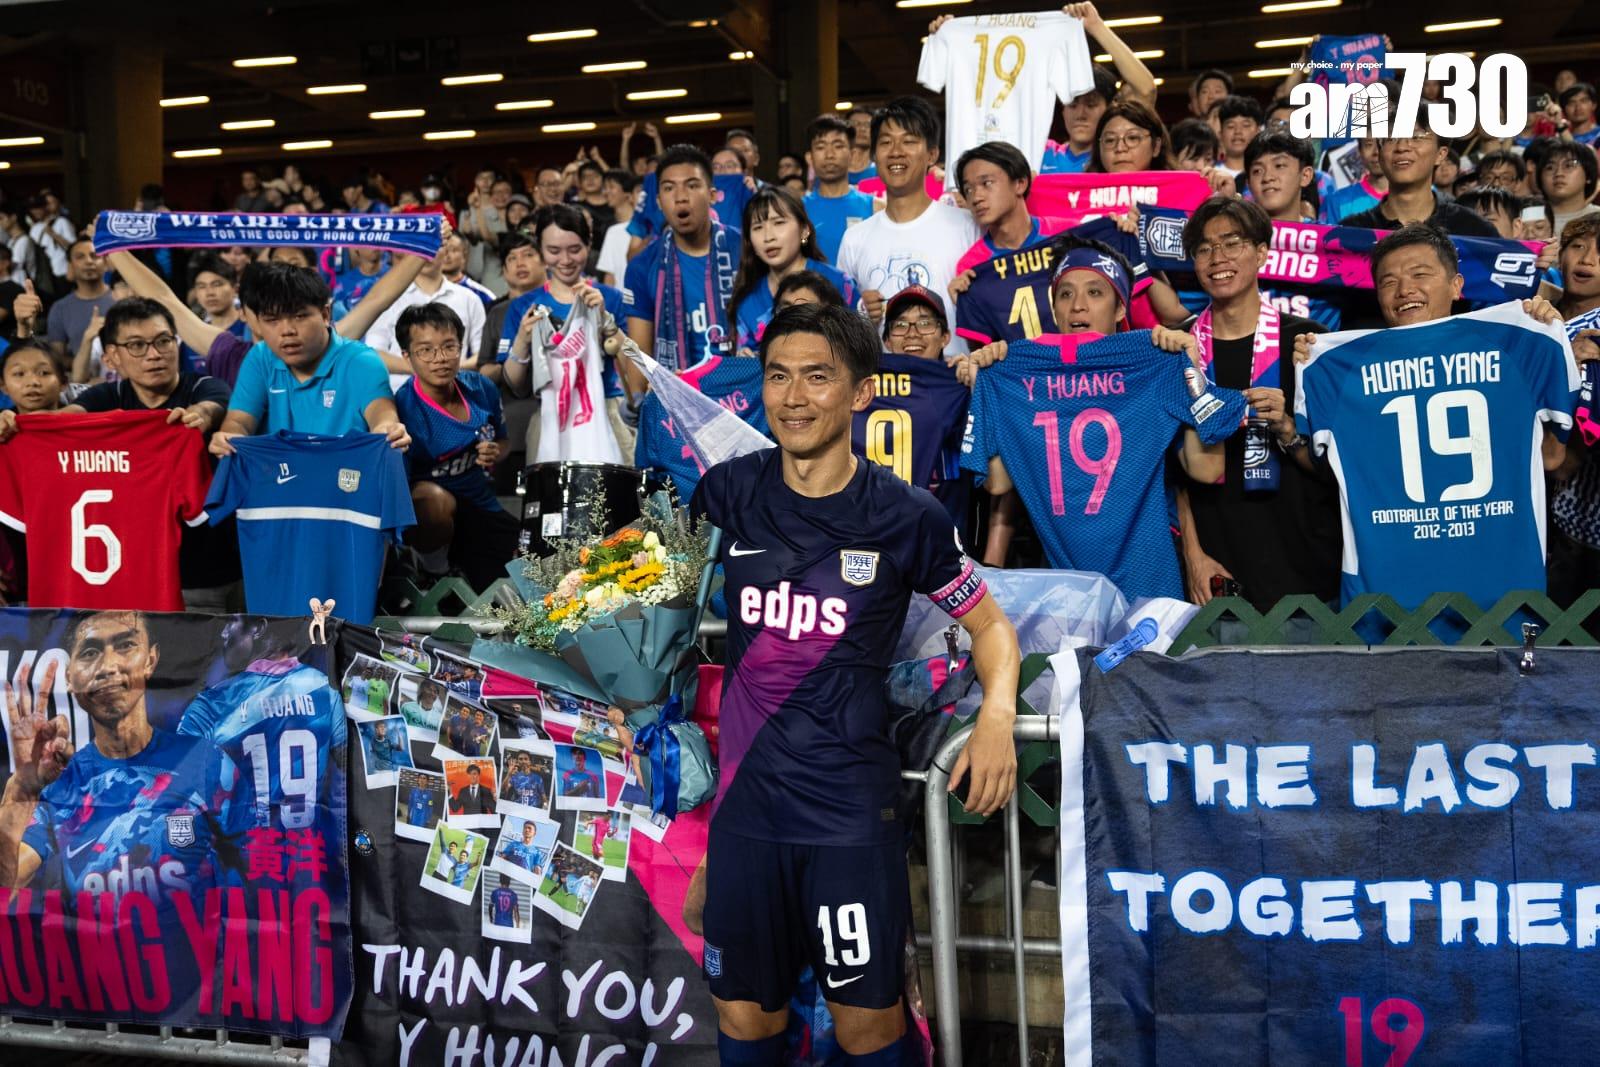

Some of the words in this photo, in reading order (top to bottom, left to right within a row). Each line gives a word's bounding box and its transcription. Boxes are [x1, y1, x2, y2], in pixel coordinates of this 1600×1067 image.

[988, 13, 1038, 28] HUANG
[13, 76, 50, 107] 103
[974, 34, 1026, 109] 19
[1068, 191, 1080, 209] Y
[1089, 186, 1158, 208] HUANG
[169, 214, 218, 228] WE
[224, 214, 288, 229] ARE
[296, 215, 436, 233] KITCHEE
[210, 229, 236, 240] FOR
[239, 229, 263, 240] THE
[266, 229, 299, 241] GOOD
[304, 230, 319, 241] OF
[323, 231, 355, 241] HONG
[359, 231, 390, 242] KONG
[993, 258, 1006, 280] Y
[1490, 252, 1538, 289] 19
[1008, 284, 1058, 339] 1
[1022, 376, 1036, 401] Y
[1047, 372, 1126, 401] HUANG
[1361, 356, 1436, 396] HUANG
[1440, 350, 1500, 386] YANG
[661, 416, 676, 439] Y
[1380, 389, 1494, 503] 19
[57, 450, 70, 474] Y
[73, 450, 131, 474] HUANG
[1032, 407, 1123, 517] 19
[1372, 507, 1440, 524] FOOTBALLER
[1444, 505, 1459, 521] OF
[1460, 502, 1482, 520] THE
[1483, 500, 1514, 517] YEAR
[1413, 521, 1476, 540] 2012-2013
[71, 489, 122, 586] 6
[740, 581, 848, 641] edps
[239, 701, 248, 723] Y
[259, 693, 316, 719] HUANG
[242, 729, 318, 829] 19
[1126, 742, 1317, 809] THE
[1352, 743, 1597, 814] LAST
[0, 886, 173, 1014] UANG
[171, 886, 335, 1026] YANG
[817, 902, 871, 967] 19
[362, 943, 547, 1013] THANK
[561, 959, 694, 1042] YOU,
[398, 1018, 428, 1067] Y
[1337, 996, 1425, 1067] 19
